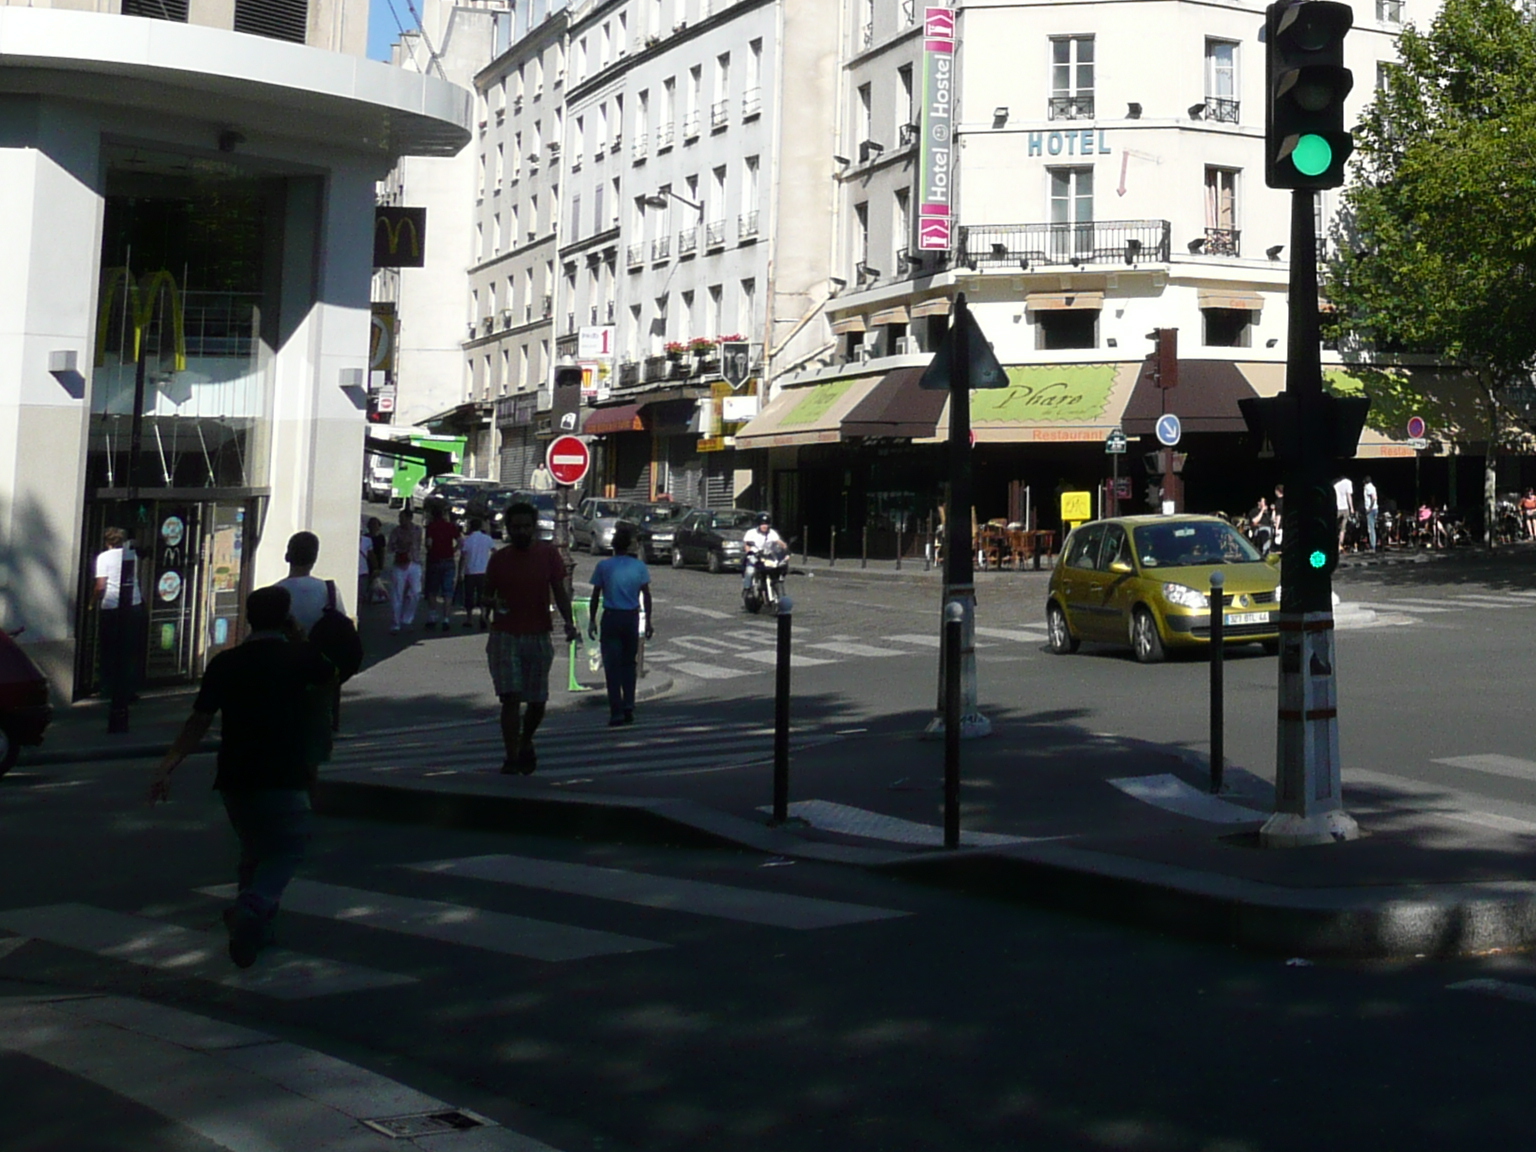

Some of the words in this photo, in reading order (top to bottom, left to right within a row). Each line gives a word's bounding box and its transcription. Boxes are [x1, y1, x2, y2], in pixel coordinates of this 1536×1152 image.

[929, 53, 953, 119] Hostel
[1027, 130, 1112, 157] HOTEL
[928, 147, 949, 202] Hotel
[1032, 429, 1104, 441] Restaurant
[1379, 446, 1415, 457] Restau
